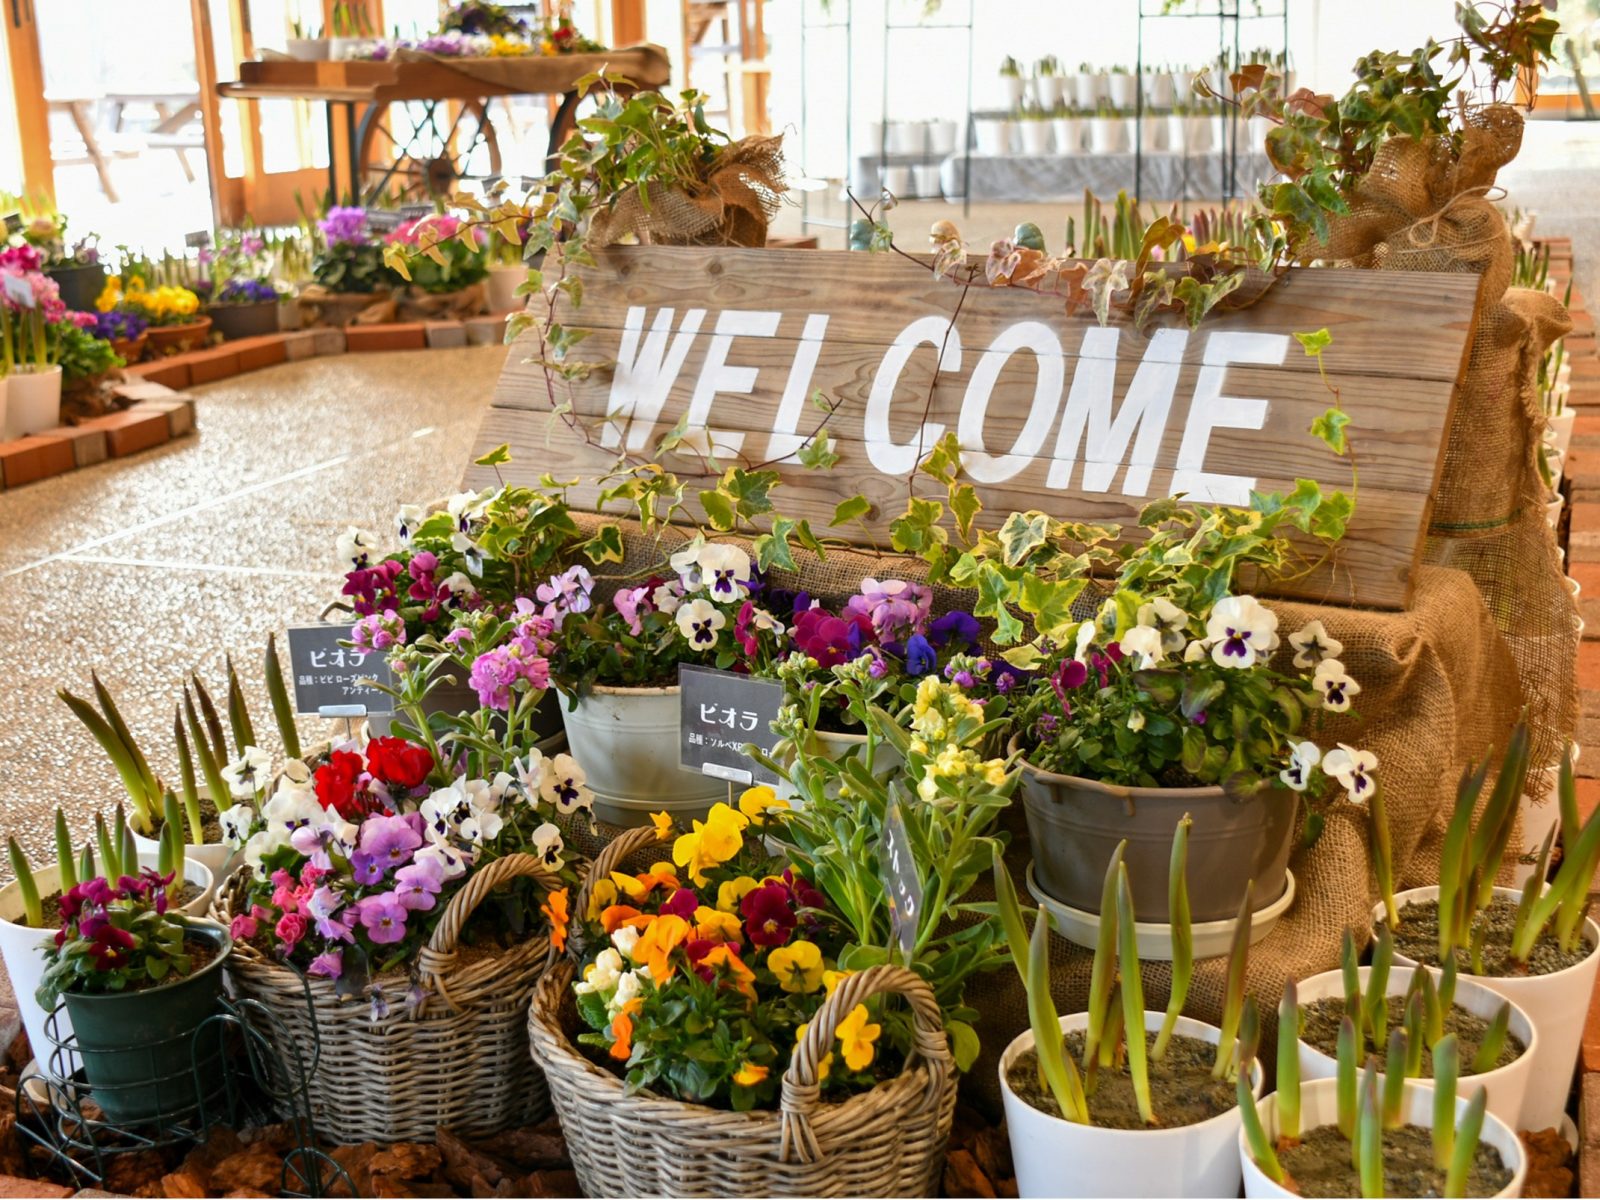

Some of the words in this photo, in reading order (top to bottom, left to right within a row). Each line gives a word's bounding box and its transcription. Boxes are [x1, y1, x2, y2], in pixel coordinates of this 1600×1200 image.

[601, 305, 1290, 507] WELCOME
[310, 648, 366, 668] ビオラ
[700, 703, 758, 731] ビオラ
